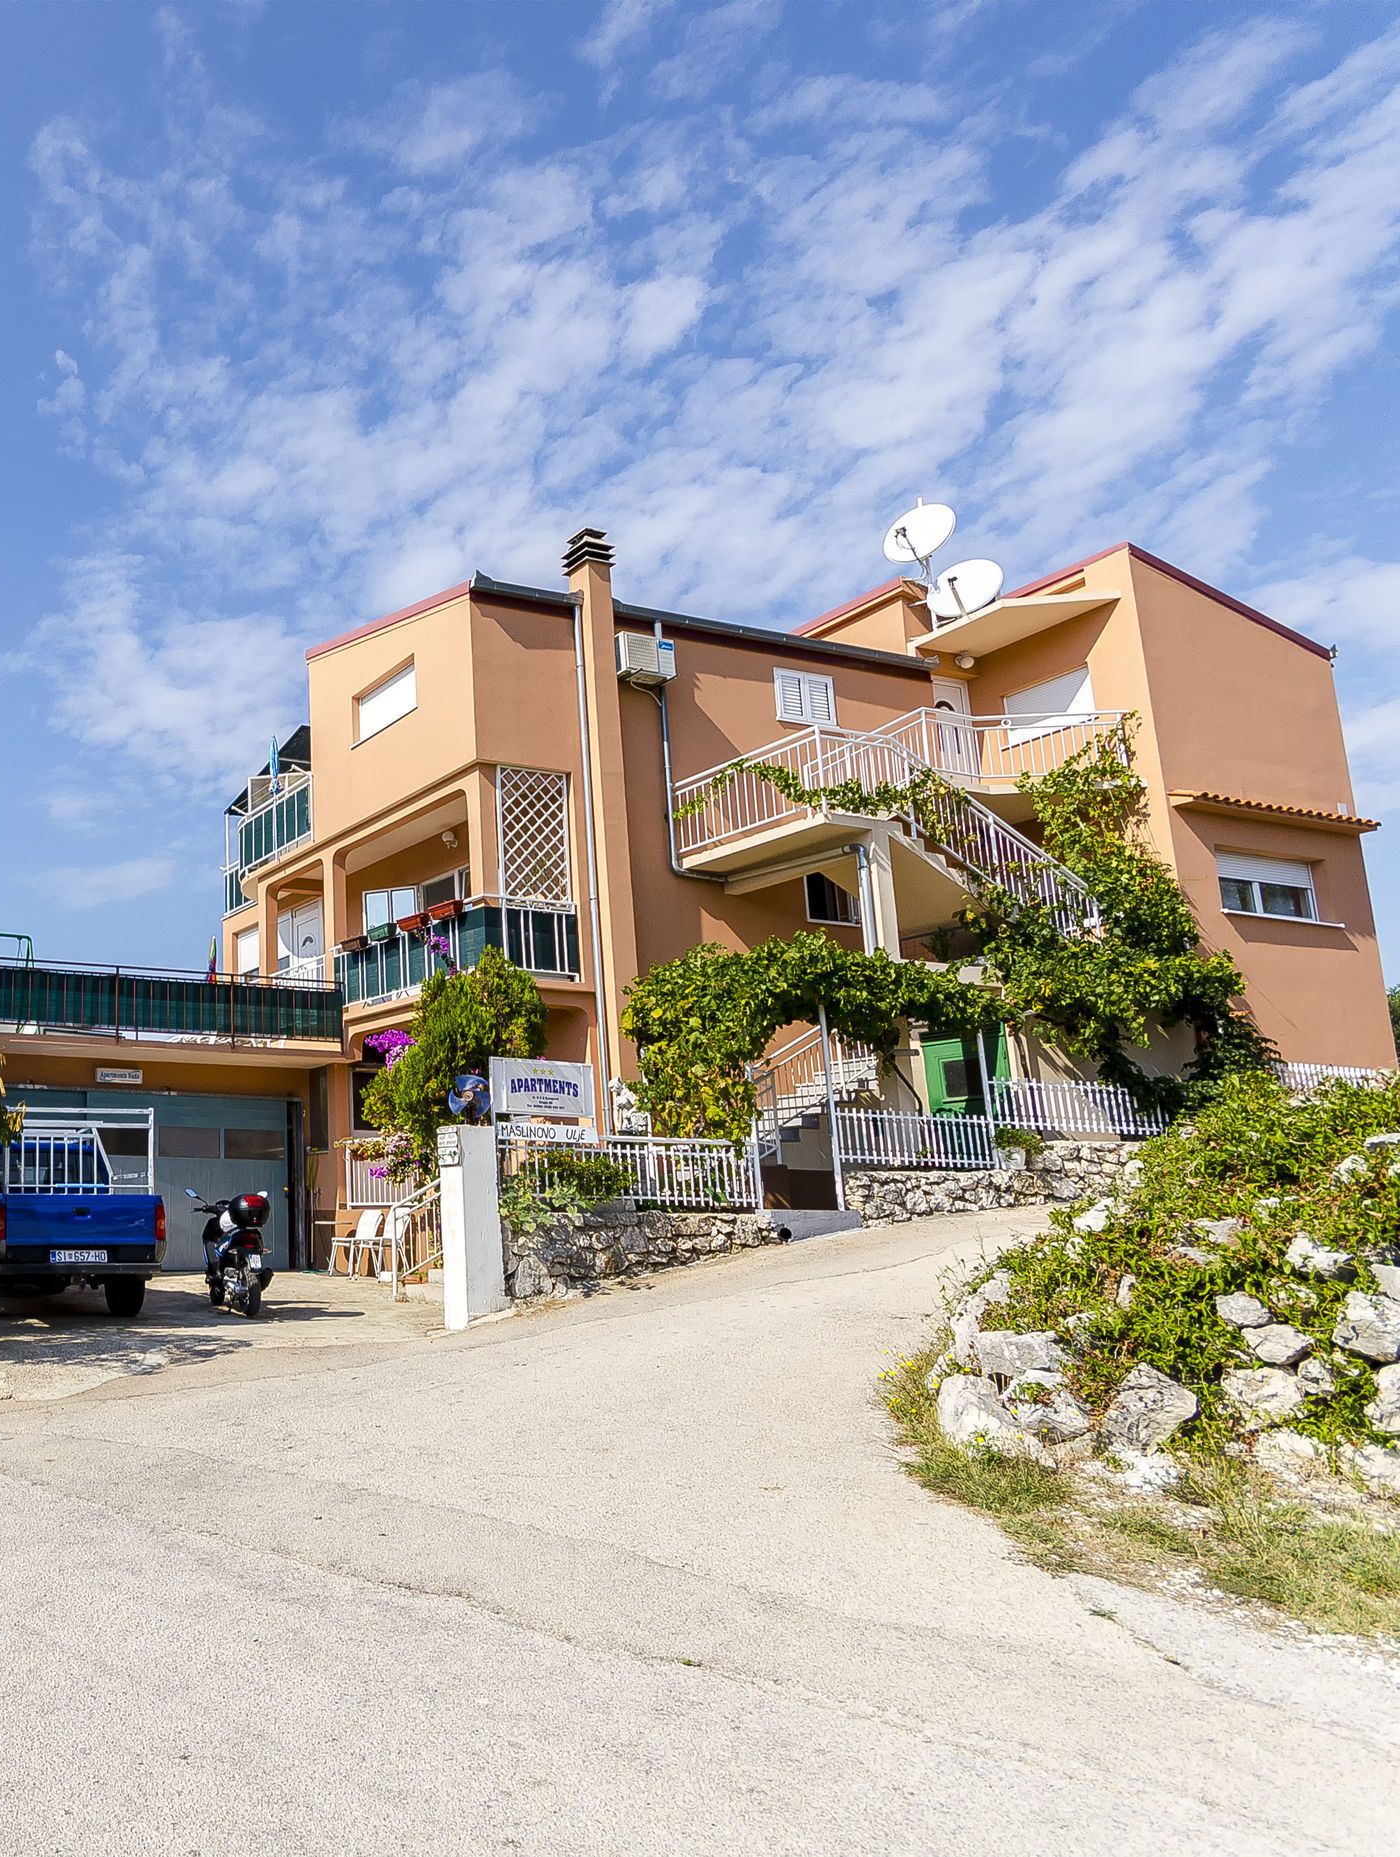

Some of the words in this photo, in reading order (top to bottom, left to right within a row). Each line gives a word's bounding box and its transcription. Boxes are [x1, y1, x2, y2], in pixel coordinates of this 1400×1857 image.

[510, 1078, 579, 1098] APARTMENTS
[501, 1124, 556, 1140] MASLINOVO
[57, 1251, 67, 1262] SI
